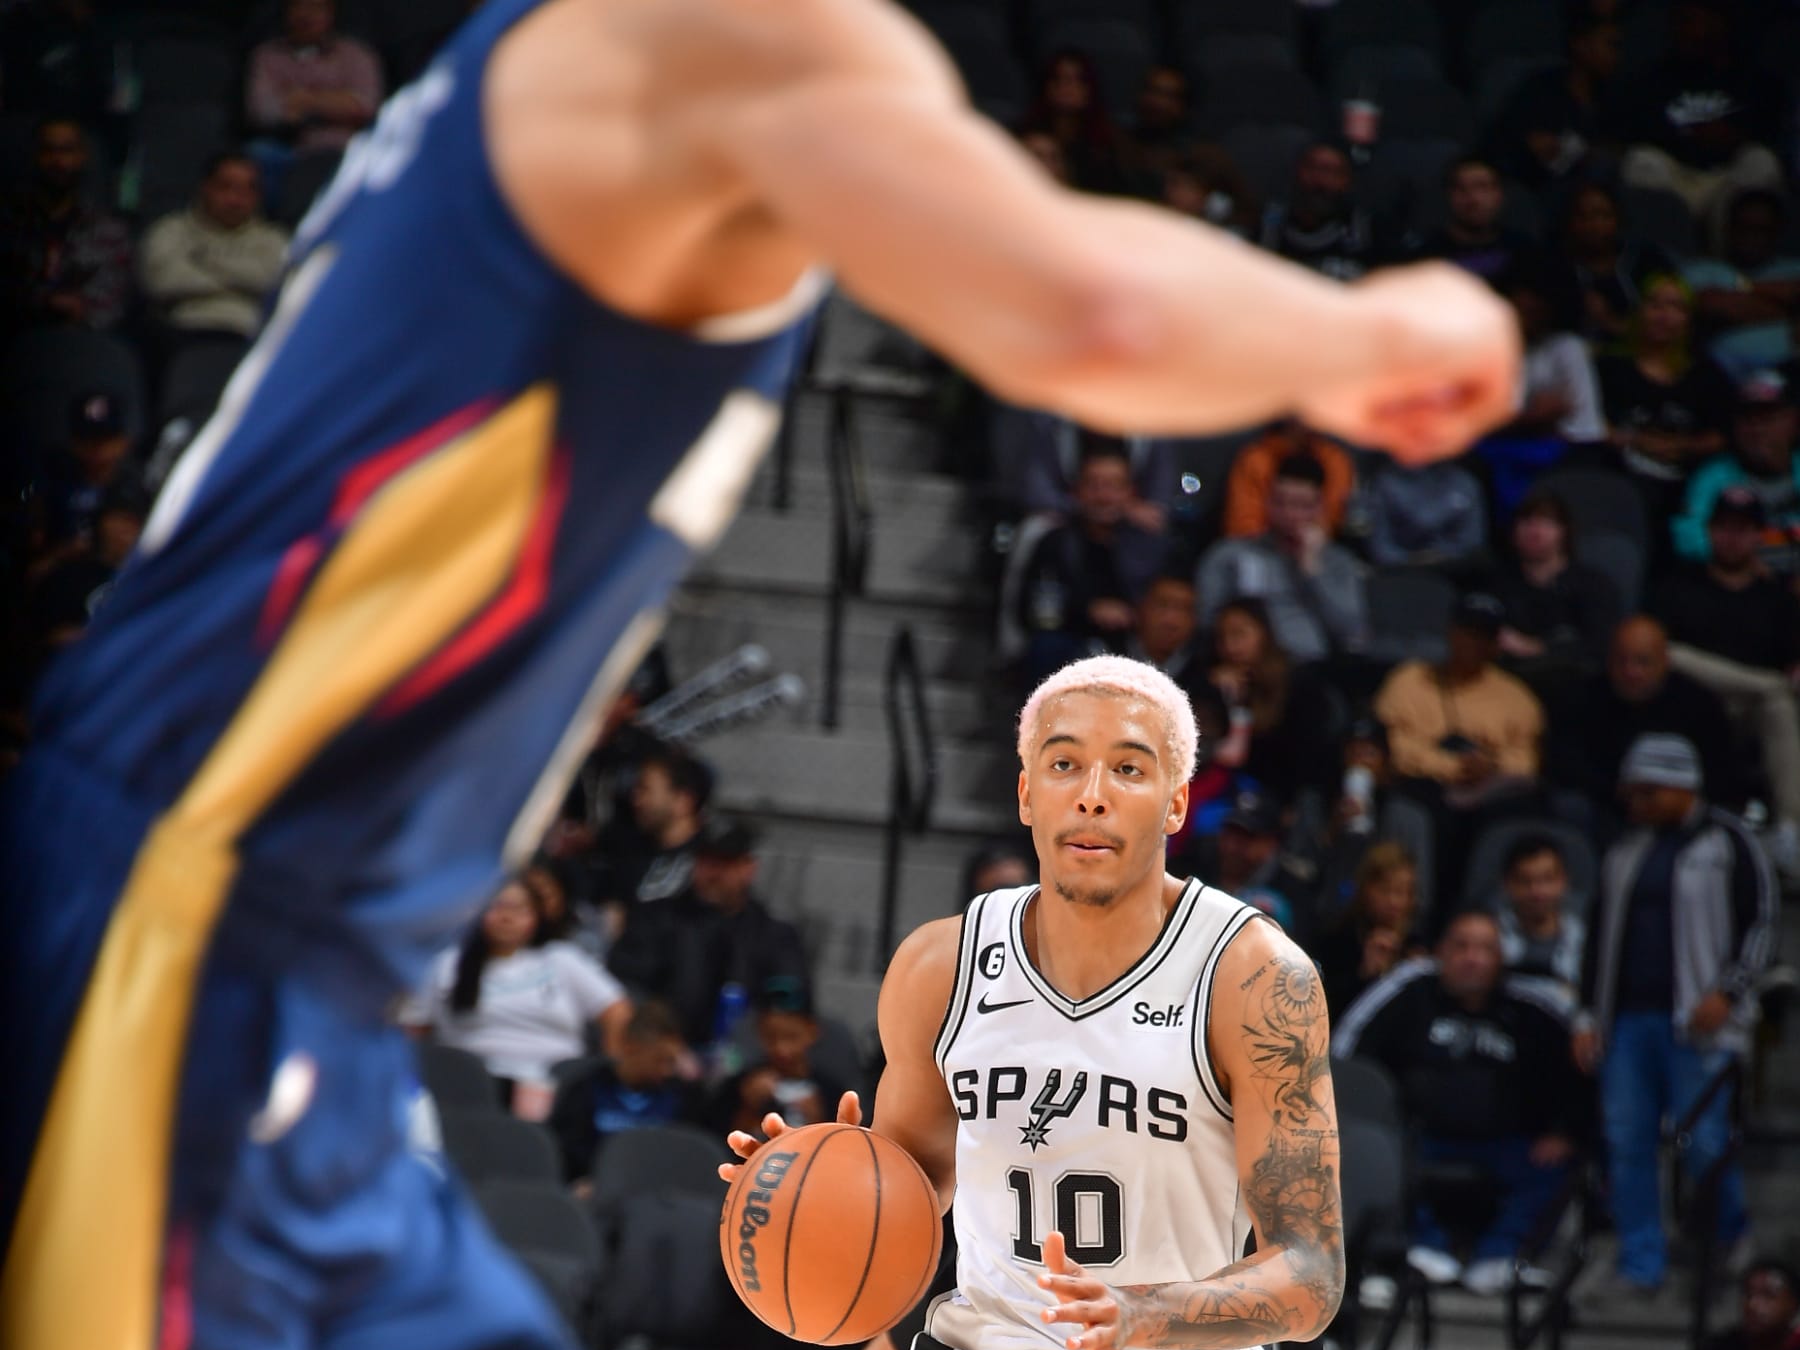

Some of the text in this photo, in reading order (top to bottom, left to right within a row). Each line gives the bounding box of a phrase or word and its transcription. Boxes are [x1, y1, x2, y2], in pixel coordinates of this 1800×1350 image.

[1131, 1001, 1185, 1027] Self.
[952, 1067, 1188, 1153] SPURS
[739, 1151, 799, 1292] Wilson
[1006, 1165, 1126, 1267] 10
